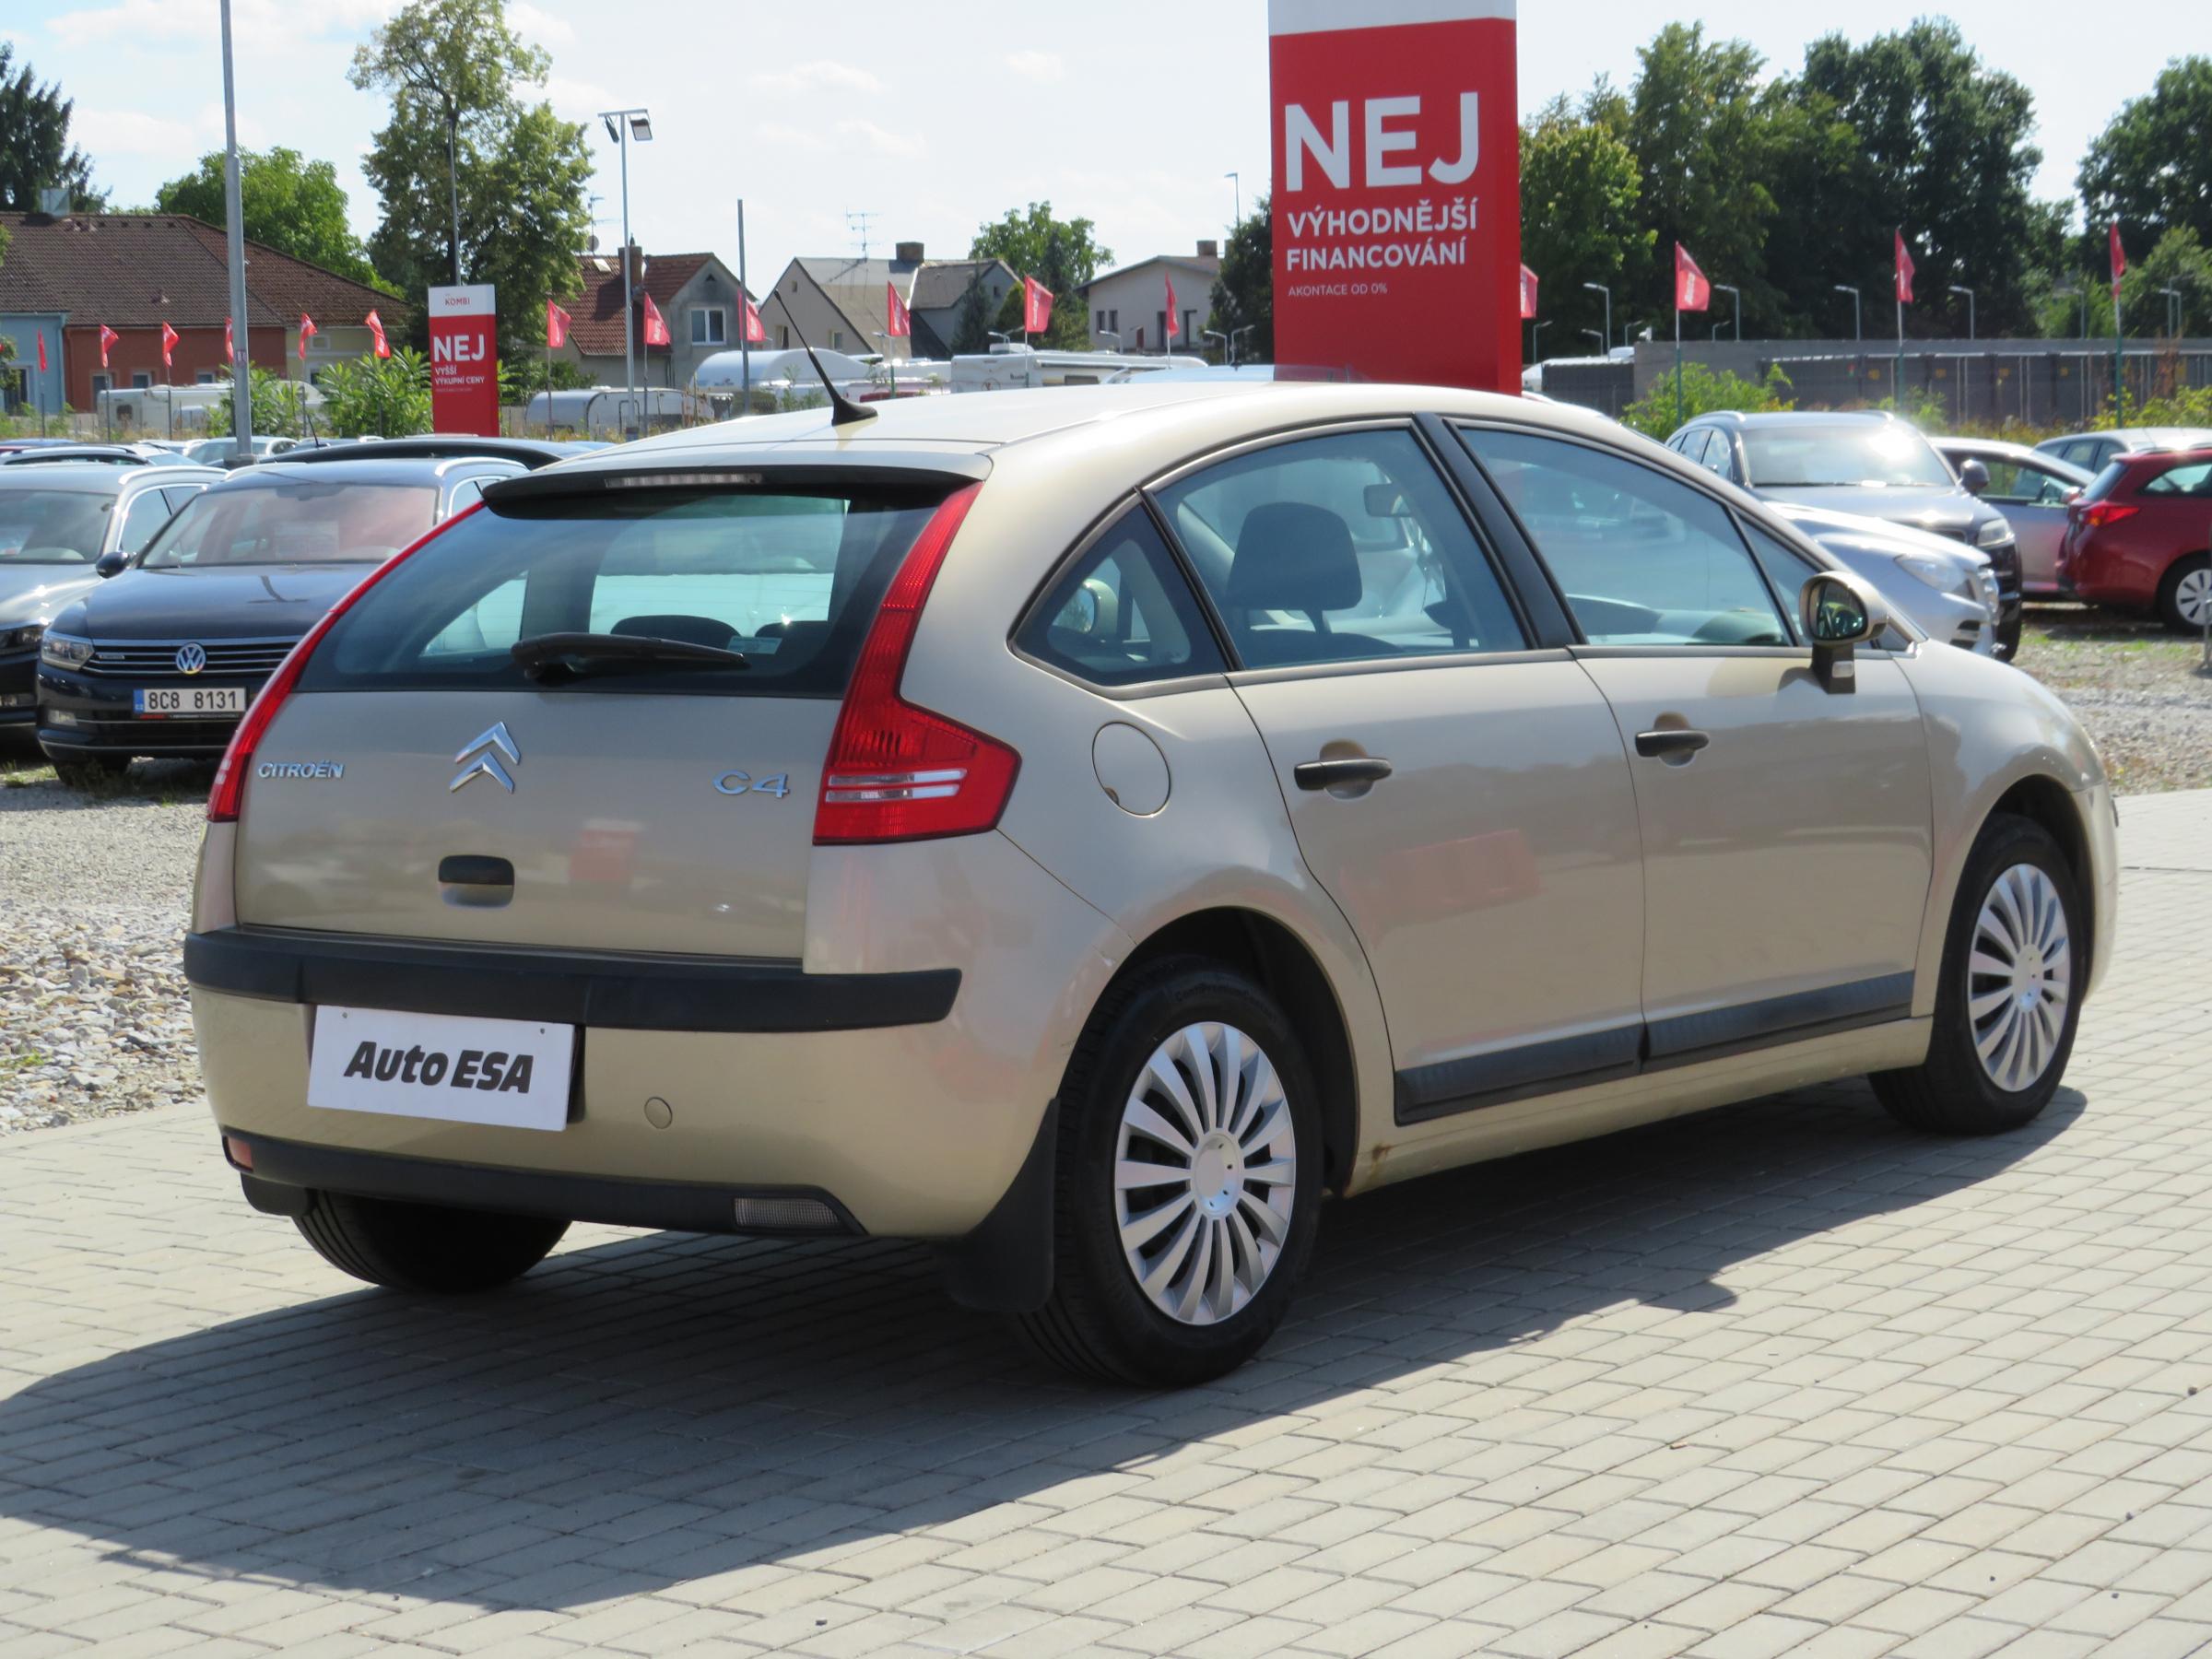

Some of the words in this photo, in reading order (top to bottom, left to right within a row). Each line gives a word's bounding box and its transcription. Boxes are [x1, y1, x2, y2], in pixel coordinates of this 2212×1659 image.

[1285, 91, 1479, 192] NEJ
[1288, 196, 1477, 238] VÝHODNĚJŠÍ
[1287, 236, 1466, 271] FINANCOVÁNÍ
[1288, 284, 1347, 297] AKONTACE
[1351, 284, 1368, 295] OD
[1371, 283, 1387, 294] 0%
[433, 334, 485, 362] NEJ
[465, 376, 485, 384] CENY
[176, 642, 206, 674] VW
[148, 692, 180, 709] 8C8
[194, 691, 236, 709] 8131
[258, 759, 345, 778] CITROËN
[712, 770, 790, 798] C4
[344, 1041, 449, 1086] Auto
[450, 1050, 534, 1093] ESA
